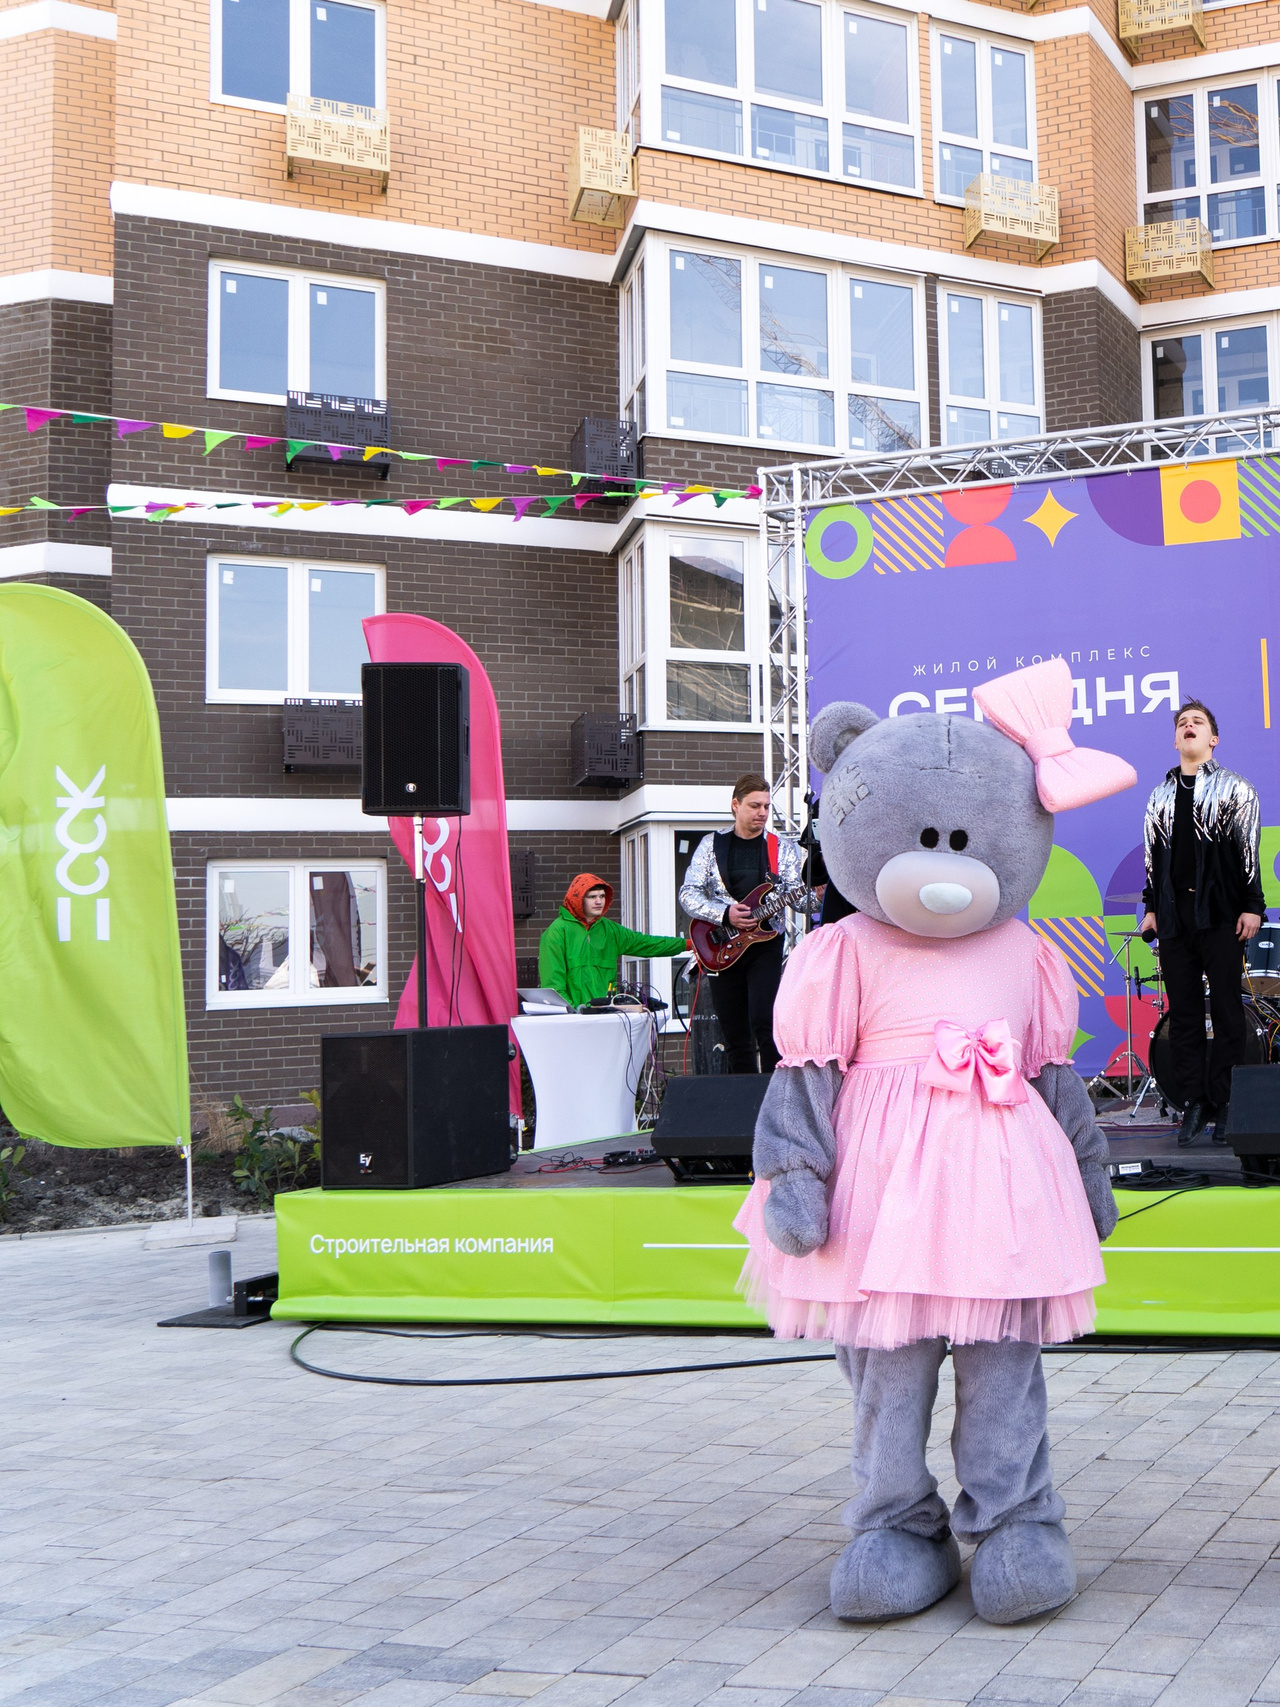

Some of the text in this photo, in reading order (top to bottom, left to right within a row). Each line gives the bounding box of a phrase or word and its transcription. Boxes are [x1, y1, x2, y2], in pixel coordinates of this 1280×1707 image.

[912, 656, 998, 677] ЖИЛОЙ
[888, 671, 1181, 726] СЕДНЯ
[309, 1234, 555, 1259] Строительная компания
